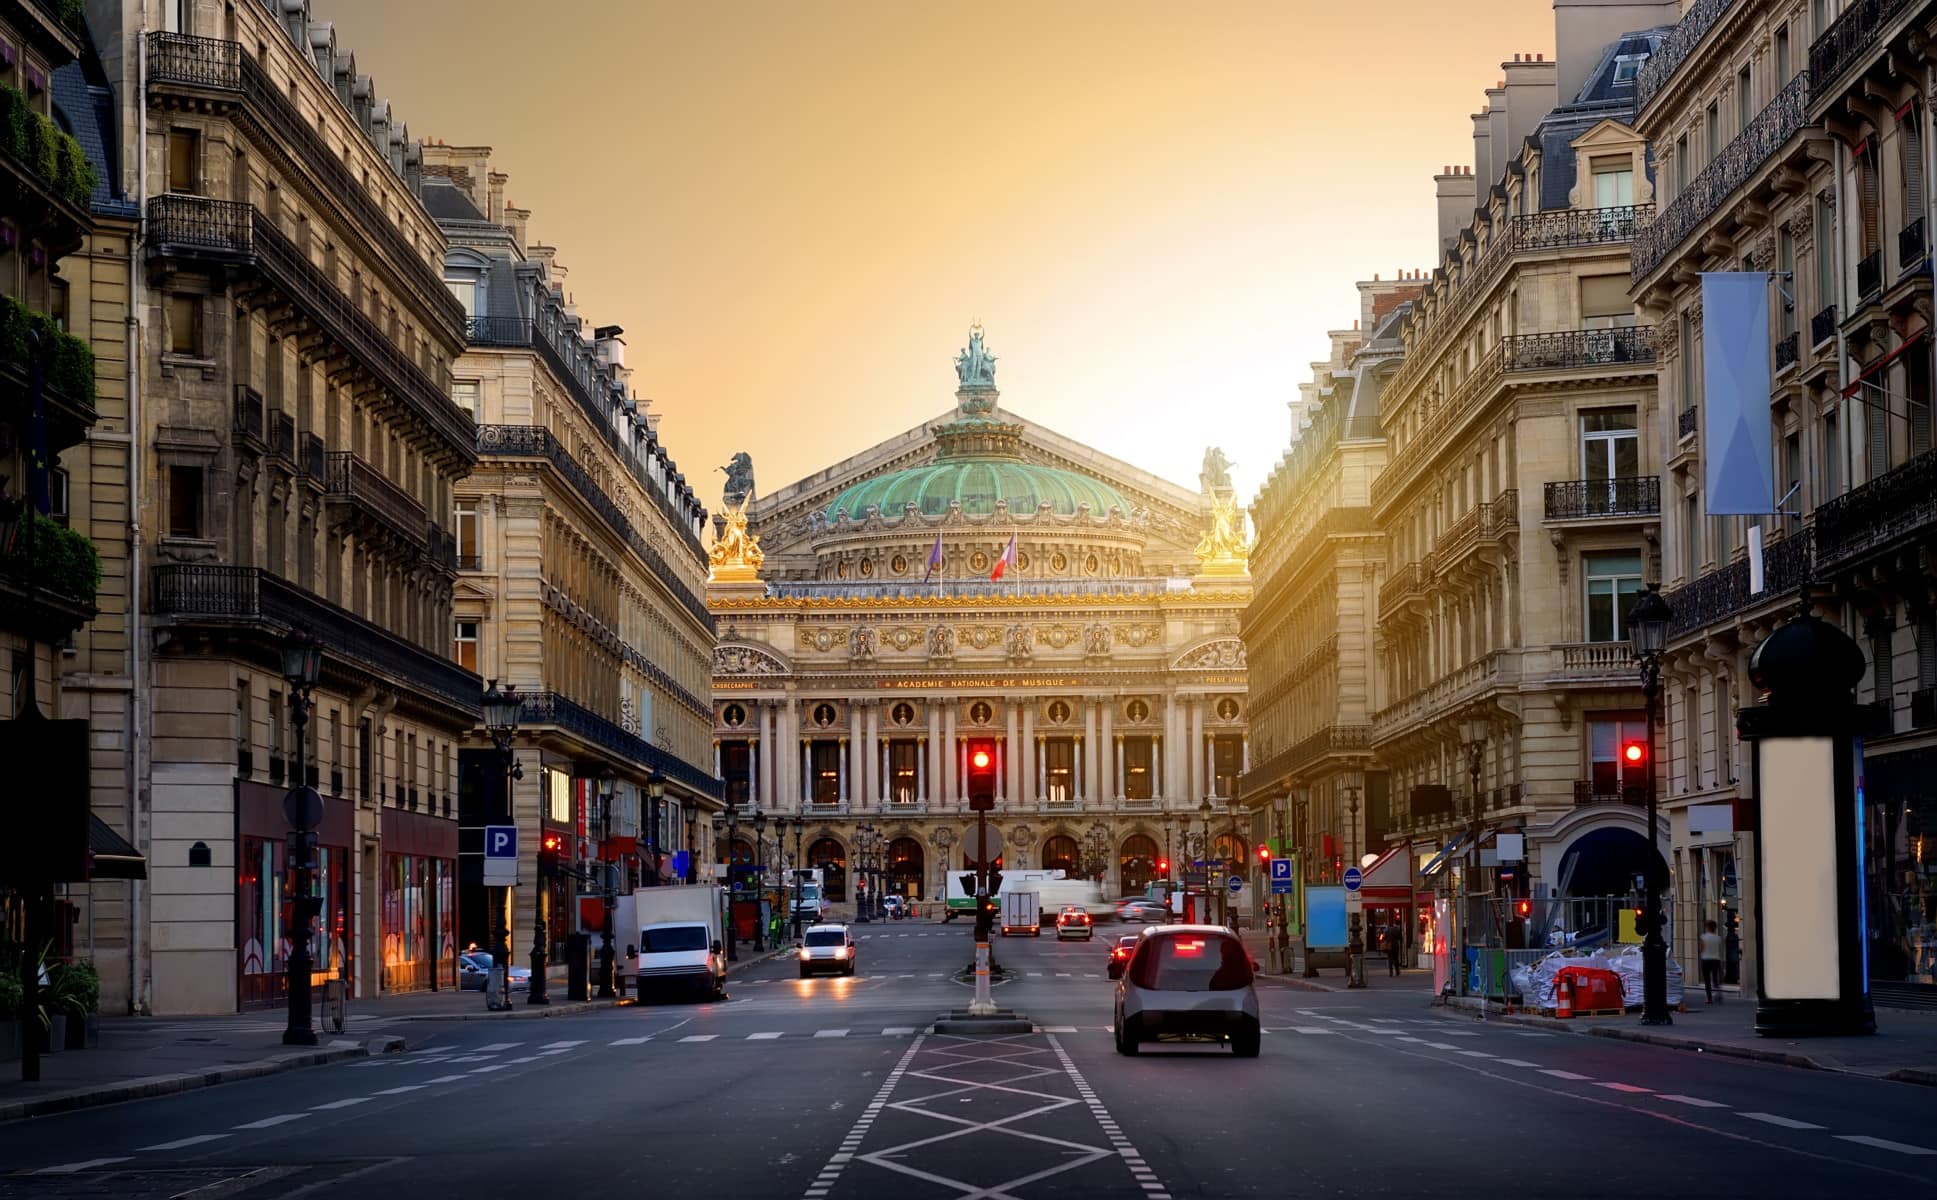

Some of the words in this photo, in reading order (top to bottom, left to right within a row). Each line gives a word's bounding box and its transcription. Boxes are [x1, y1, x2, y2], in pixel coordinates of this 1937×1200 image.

[897, 680, 944, 688] ACADEMIE
[1002, 679, 1016, 687] DE
[494, 832, 509, 852] P
[1277, 863, 1287, 876] P
